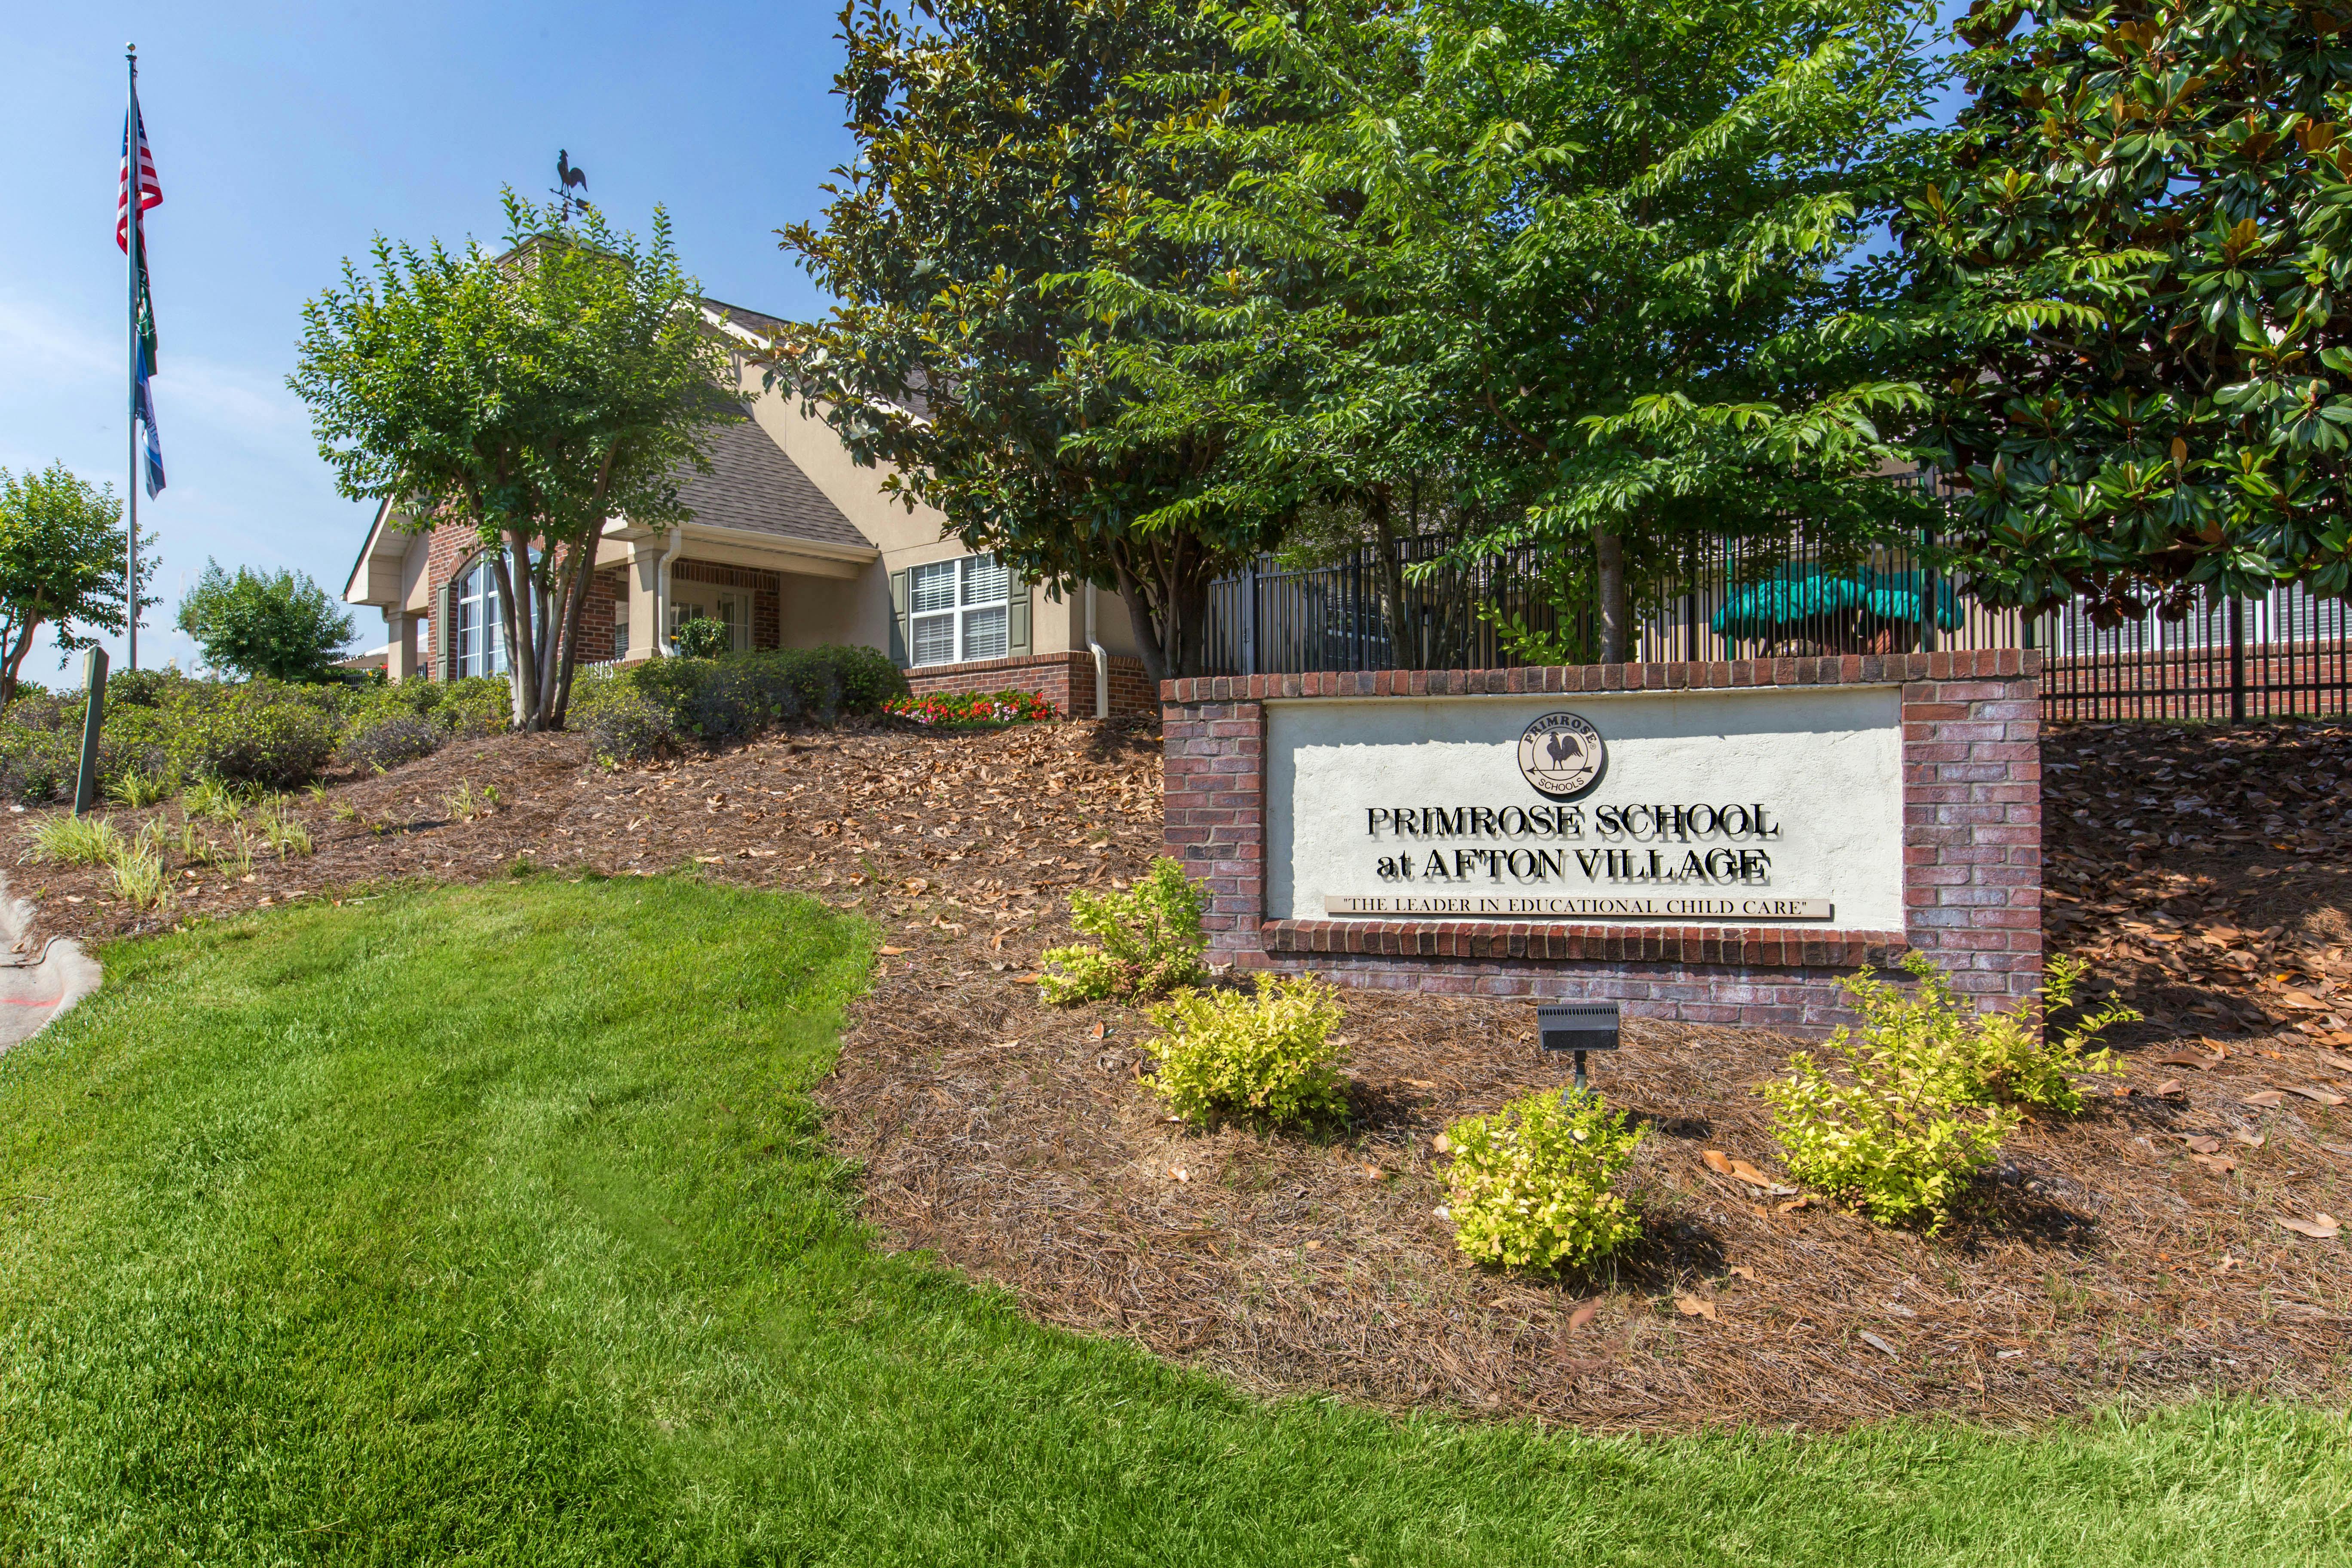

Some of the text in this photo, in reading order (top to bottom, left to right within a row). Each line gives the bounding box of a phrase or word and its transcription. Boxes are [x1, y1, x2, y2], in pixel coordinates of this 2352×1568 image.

[1538, 777, 1584, 791] SCHOOLS
[1365, 803, 1779, 835] PRIMROSE SCHOOL
[1376, 847, 1769, 879] at AFTON VILLAGE
[1344, 898, 1807, 915] "THE LEADER IN EDUCATIONAL CHILD CARE"
